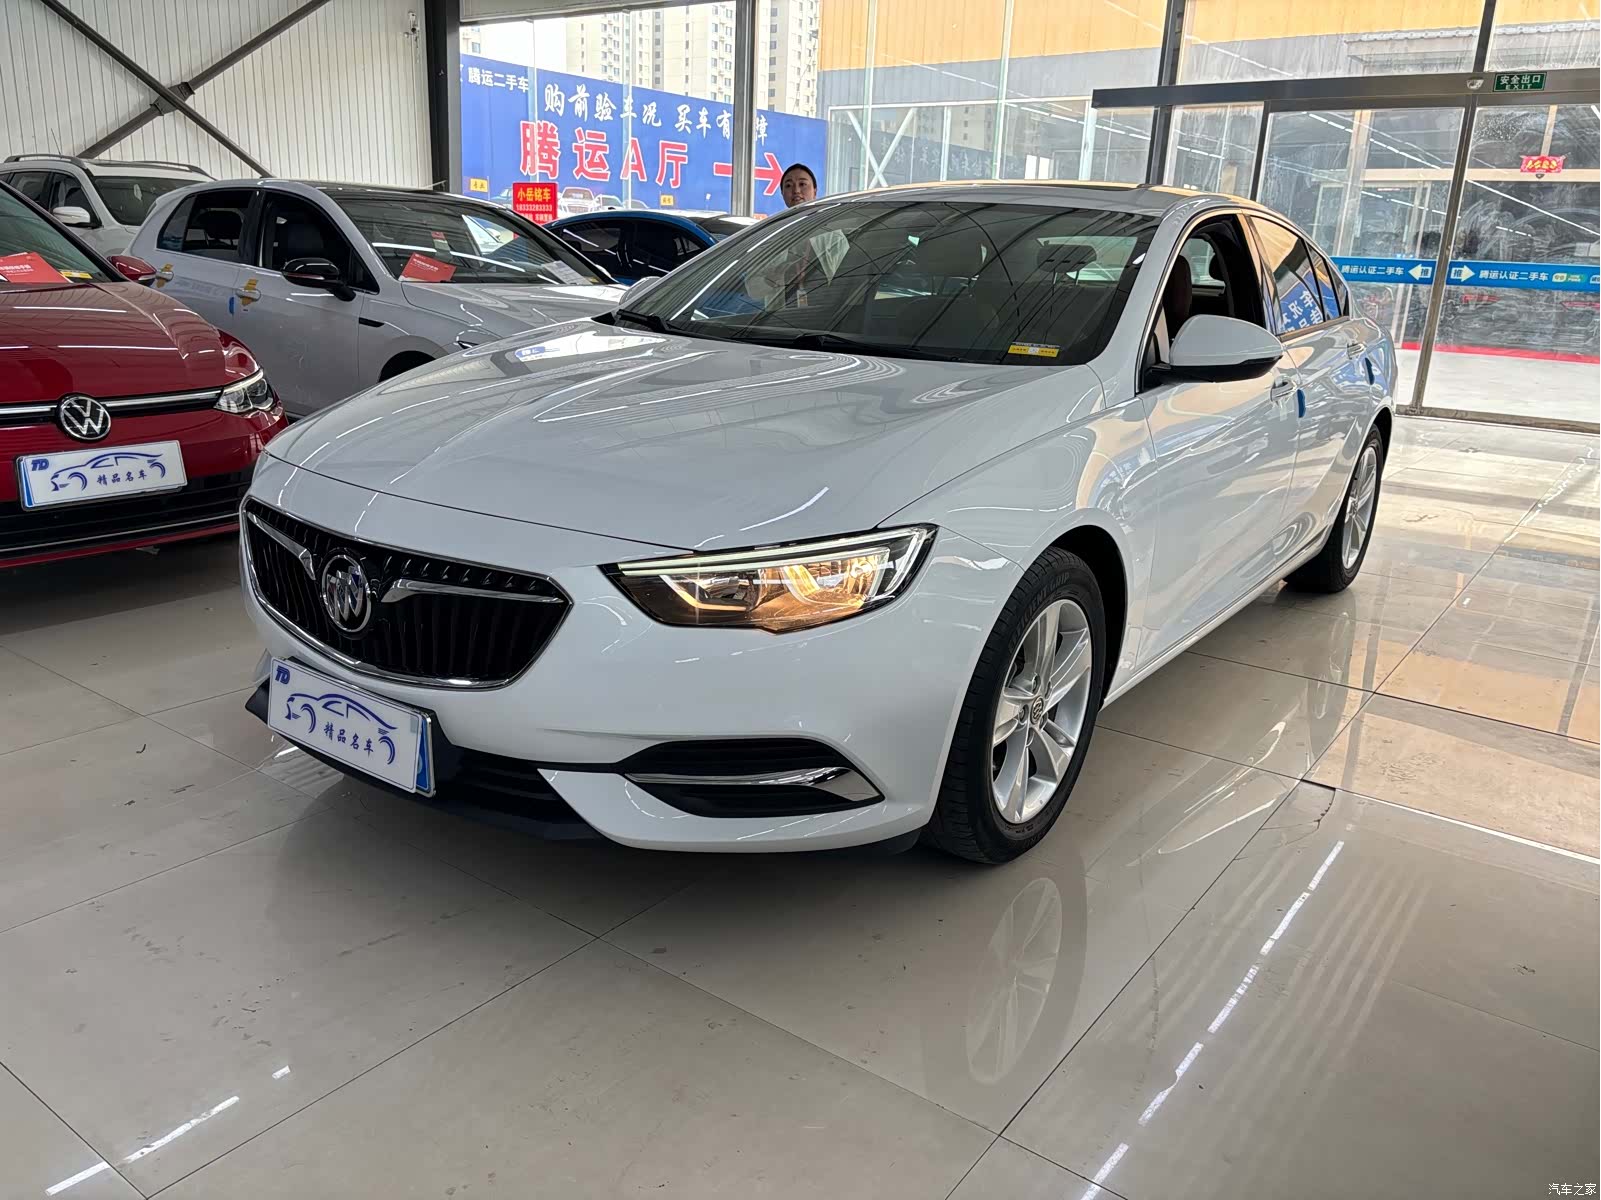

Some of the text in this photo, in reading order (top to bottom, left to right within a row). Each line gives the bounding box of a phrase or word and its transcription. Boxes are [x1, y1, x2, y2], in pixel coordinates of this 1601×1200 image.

[468, 67, 529, 93] 腾运二手车
[1500, 75, 1541, 84] 安全出口
[544, 83, 768, 146] 购前验车况 买车有障
[519, 119, 688, 188] 腾运A厅
[1341, 265, 1405, 276] 腾运认证二手车
[1479, 269, 1549, 282] 腾运认证二手车
[31, 458, 49, 471] TD
[97, 469, 148, 486] 精品名车
[275, 665, 291, 685] TD
[323, 721, 374, 758] 精品名车
